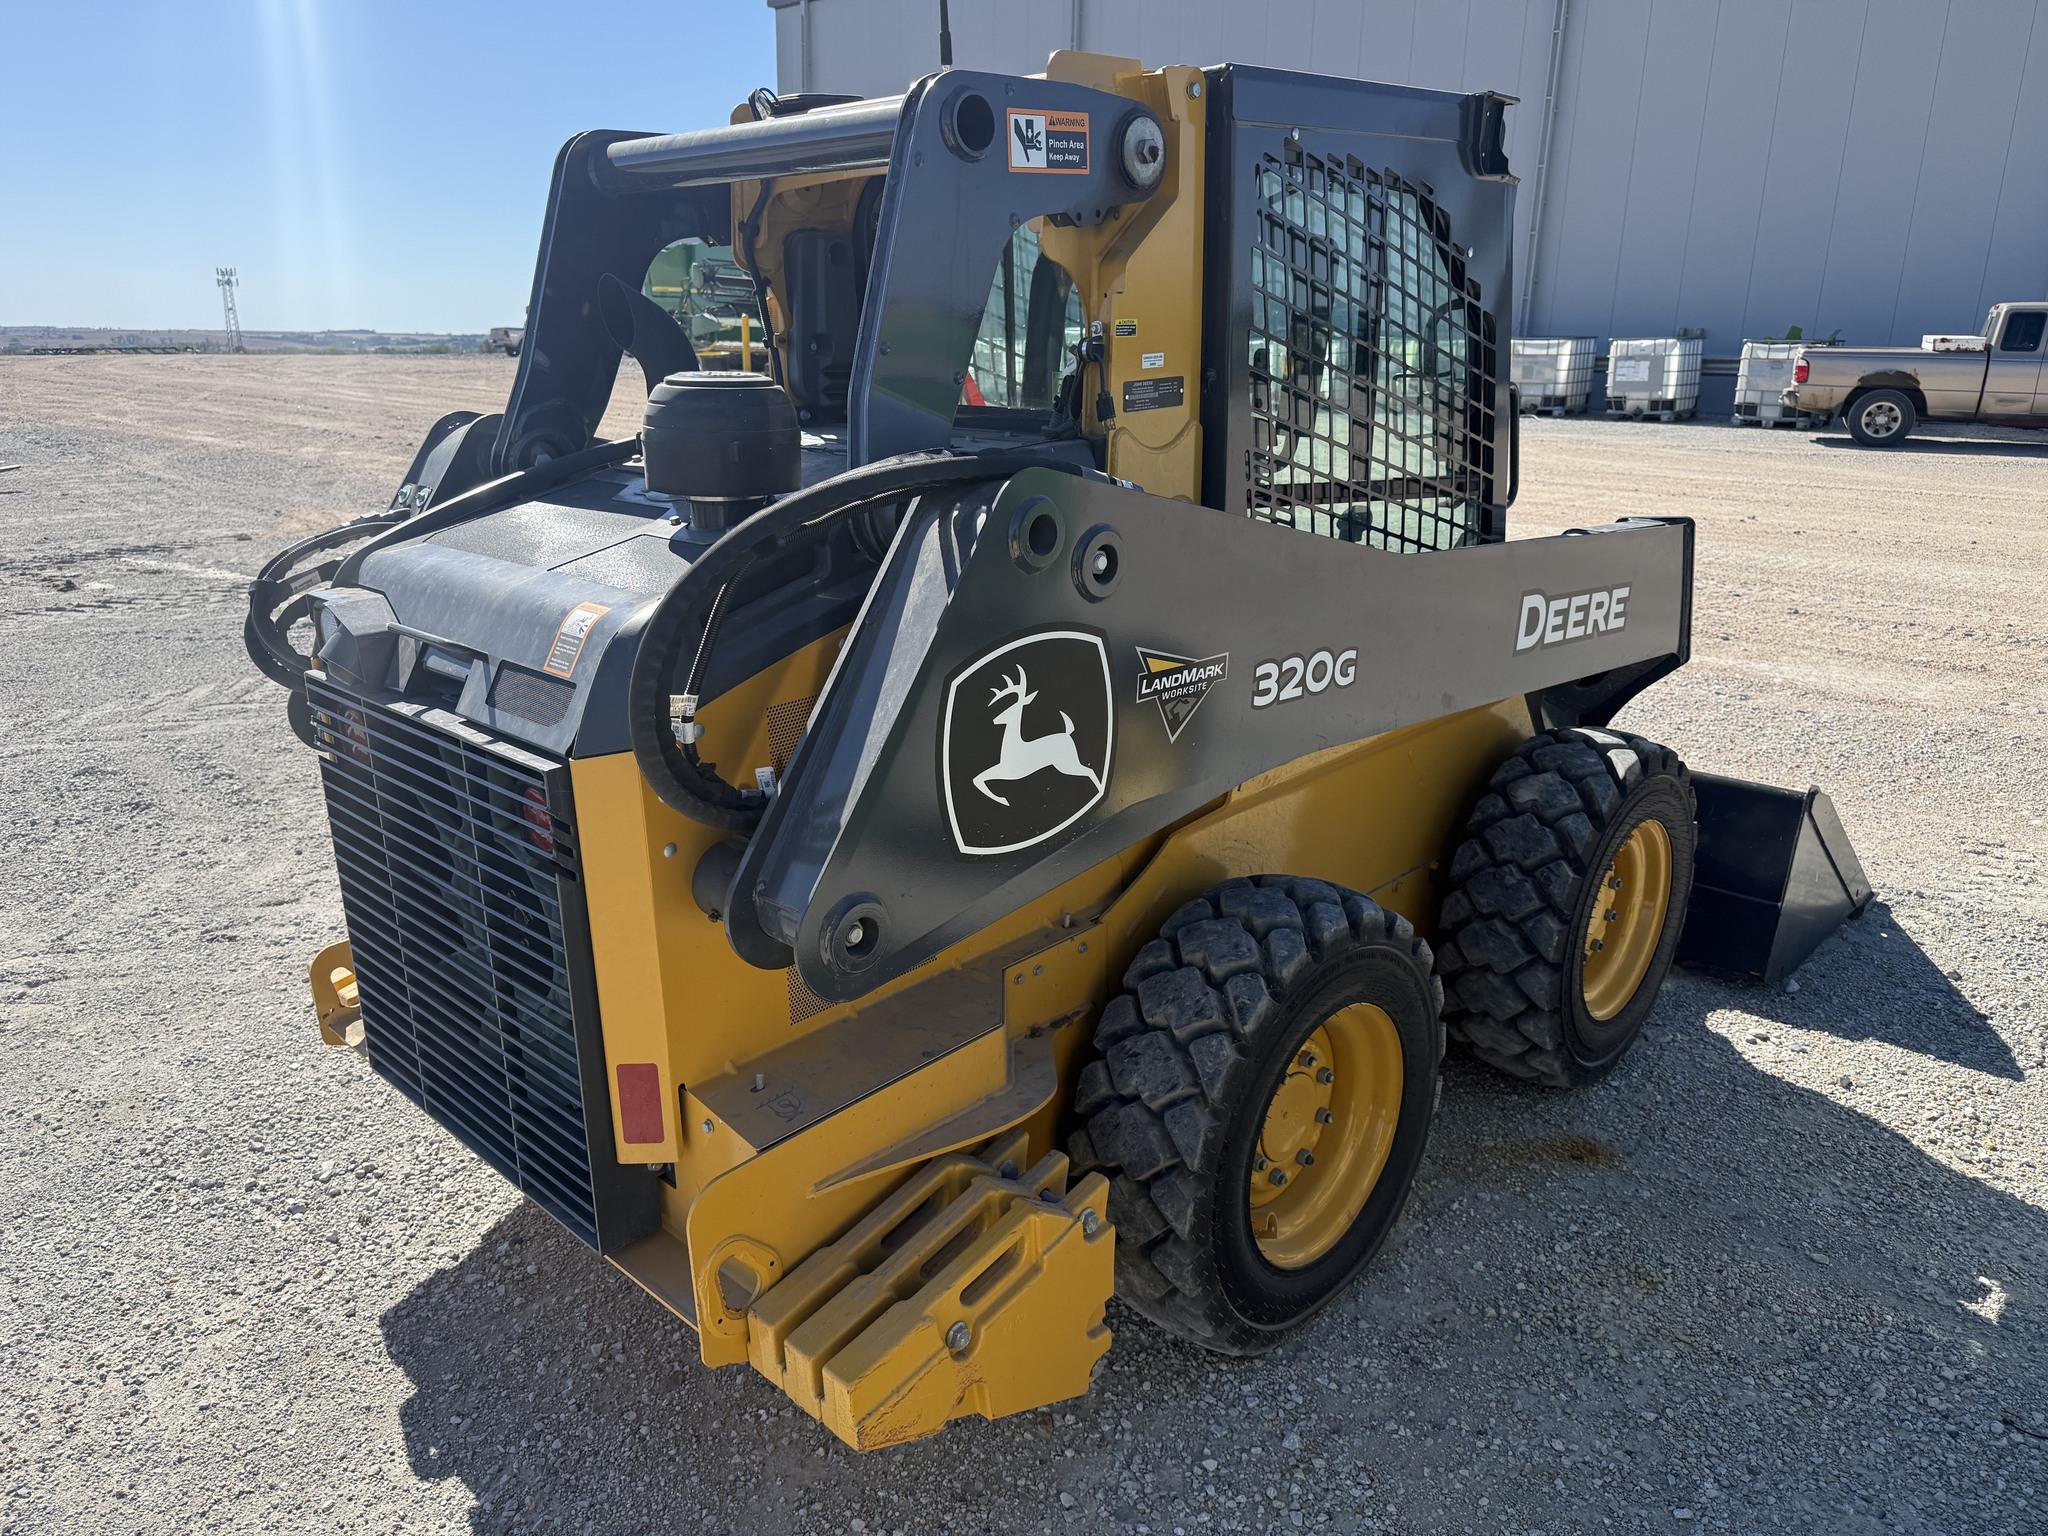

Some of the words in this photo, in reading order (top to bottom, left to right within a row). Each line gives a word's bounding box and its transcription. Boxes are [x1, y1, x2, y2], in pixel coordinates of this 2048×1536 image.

[1055, 117, 1085, 127] WARNING
[1048, 139, 1068, 149] Pinch
[1069, 140, 1085, 149] Area
[1048, 152, 1064, 162] Keep
[1064, 153, 1080, 163] Away
[1516, 586, 1631, 651] DEERE
[1141, 662, 1225, 694] LANDMARK
[1253, 649, 1357, 707] 320G
[1161, 682, 1207, 700] WORKSITE
